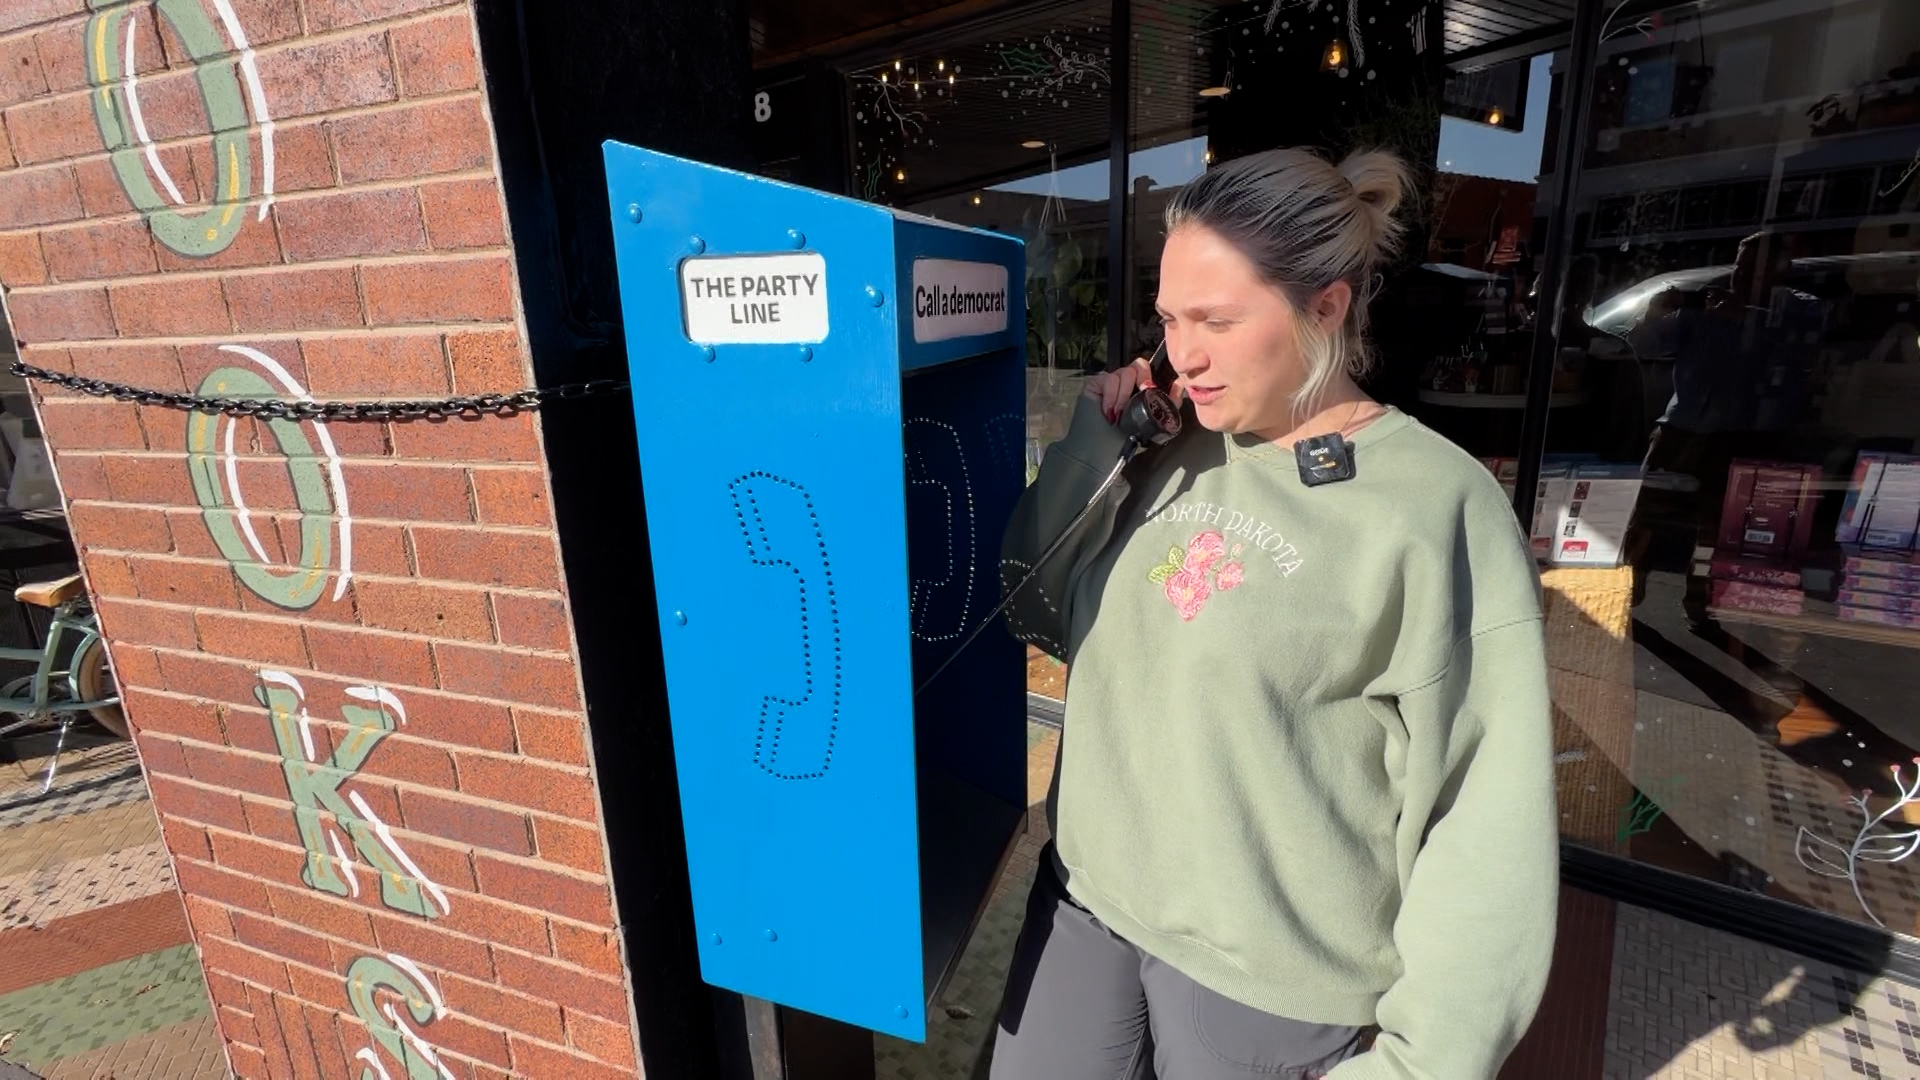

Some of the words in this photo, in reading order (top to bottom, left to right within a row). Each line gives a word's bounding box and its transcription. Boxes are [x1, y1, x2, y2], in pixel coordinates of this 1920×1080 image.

[754, 91, 772, 122] 8
[690, 276, 737, 298] THE
[741, 273, 819, 297] PARTY
[915, 284, 940, 318] Call
[942, 292, 949, 316] a
[949, 285, 1005, 316] democrat
[730, 301, 781, 324] LINE
[1145, 501, 1224, 527] NORTH
[1224, 511, 1304, 578] DAKOTA
